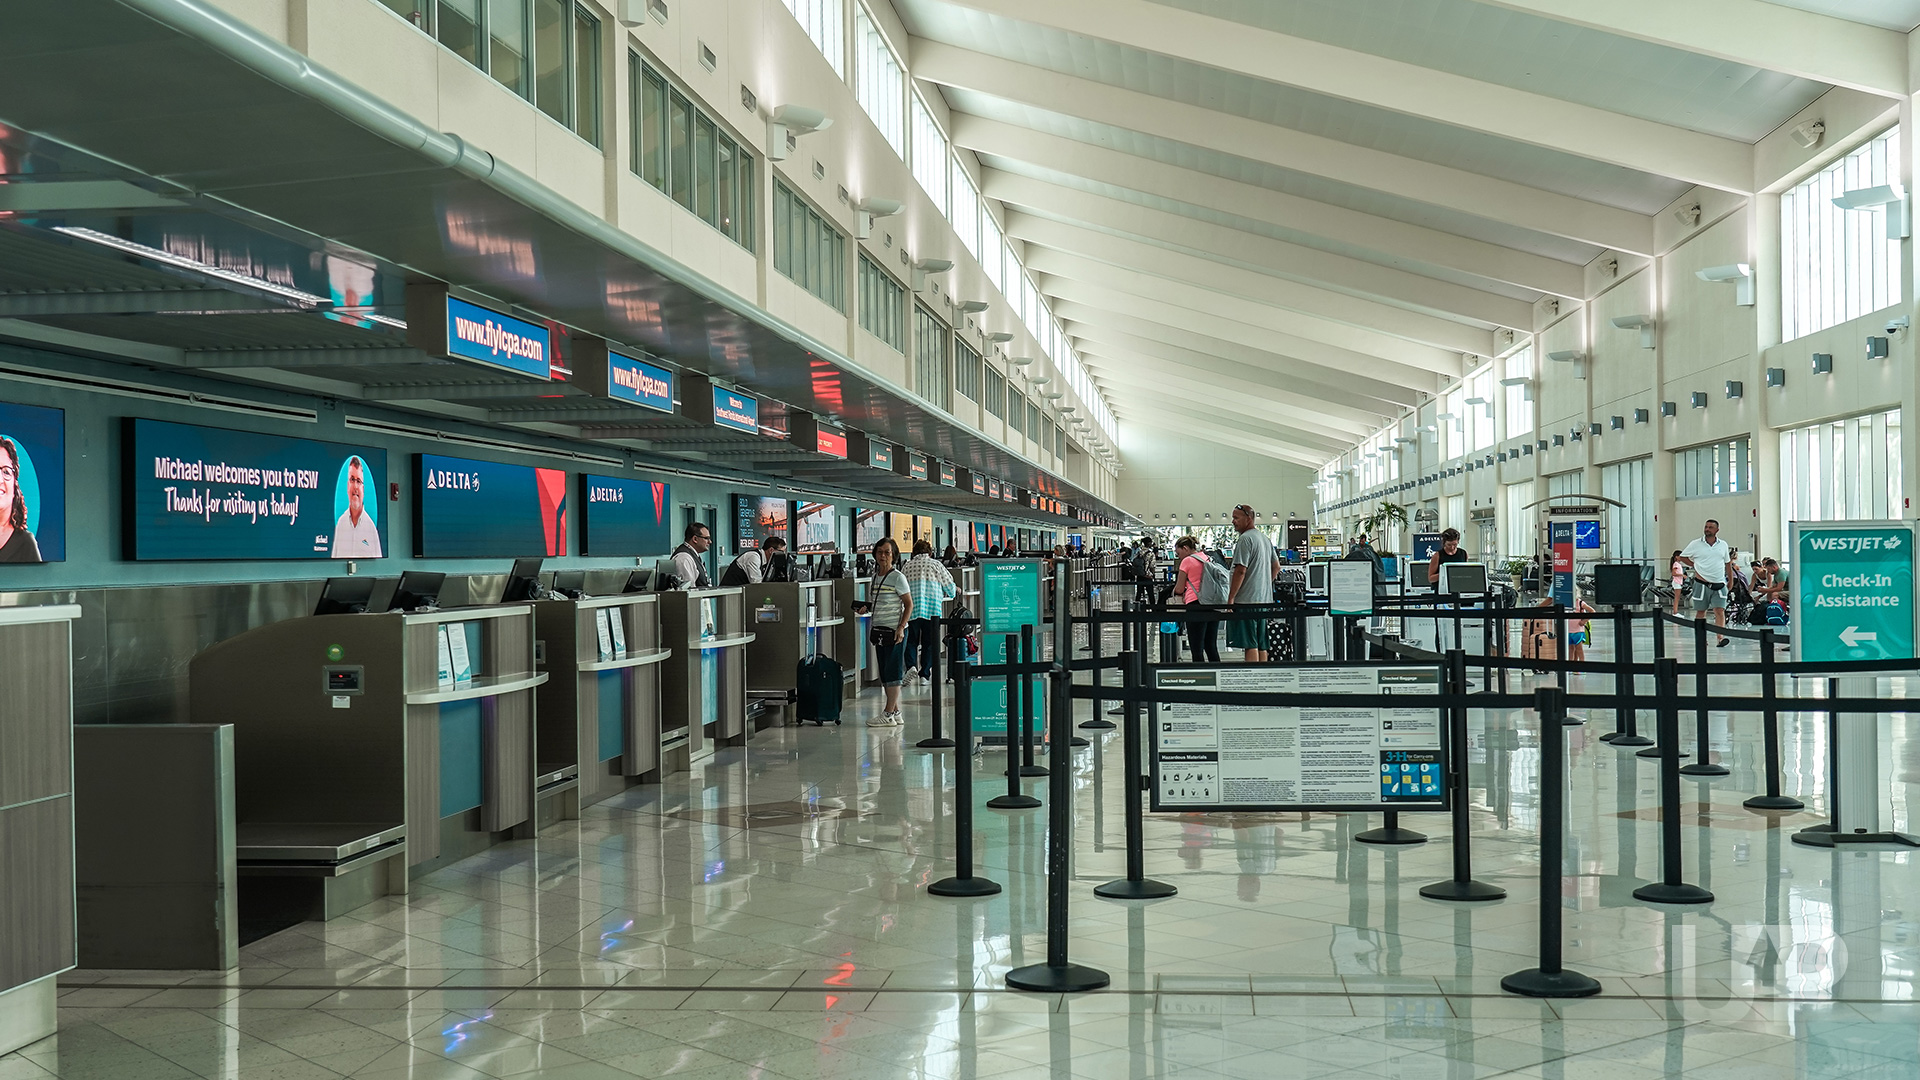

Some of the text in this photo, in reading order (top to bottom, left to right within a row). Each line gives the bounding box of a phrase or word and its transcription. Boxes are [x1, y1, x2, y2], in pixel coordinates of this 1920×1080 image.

[455, 316, 543, 361] www.flylcpa.com
[613, 366, 668, 398] www.flylcpa.com
[155, 457, 319, 489] Michael welcomes you to RSW
[438, 470, 471, 490] DELTA
[596, 488, 618, 503] DELTA
[164, 486, 299, 526] Thanks for visiting us today!
[1810, 537, 1883, 554] WESTJET
[1822, 573, 1892, 588] Check-In
[1814, 593, 1900, 608] Assistance
[1386, 751, 1407, 762] 3-1-1
